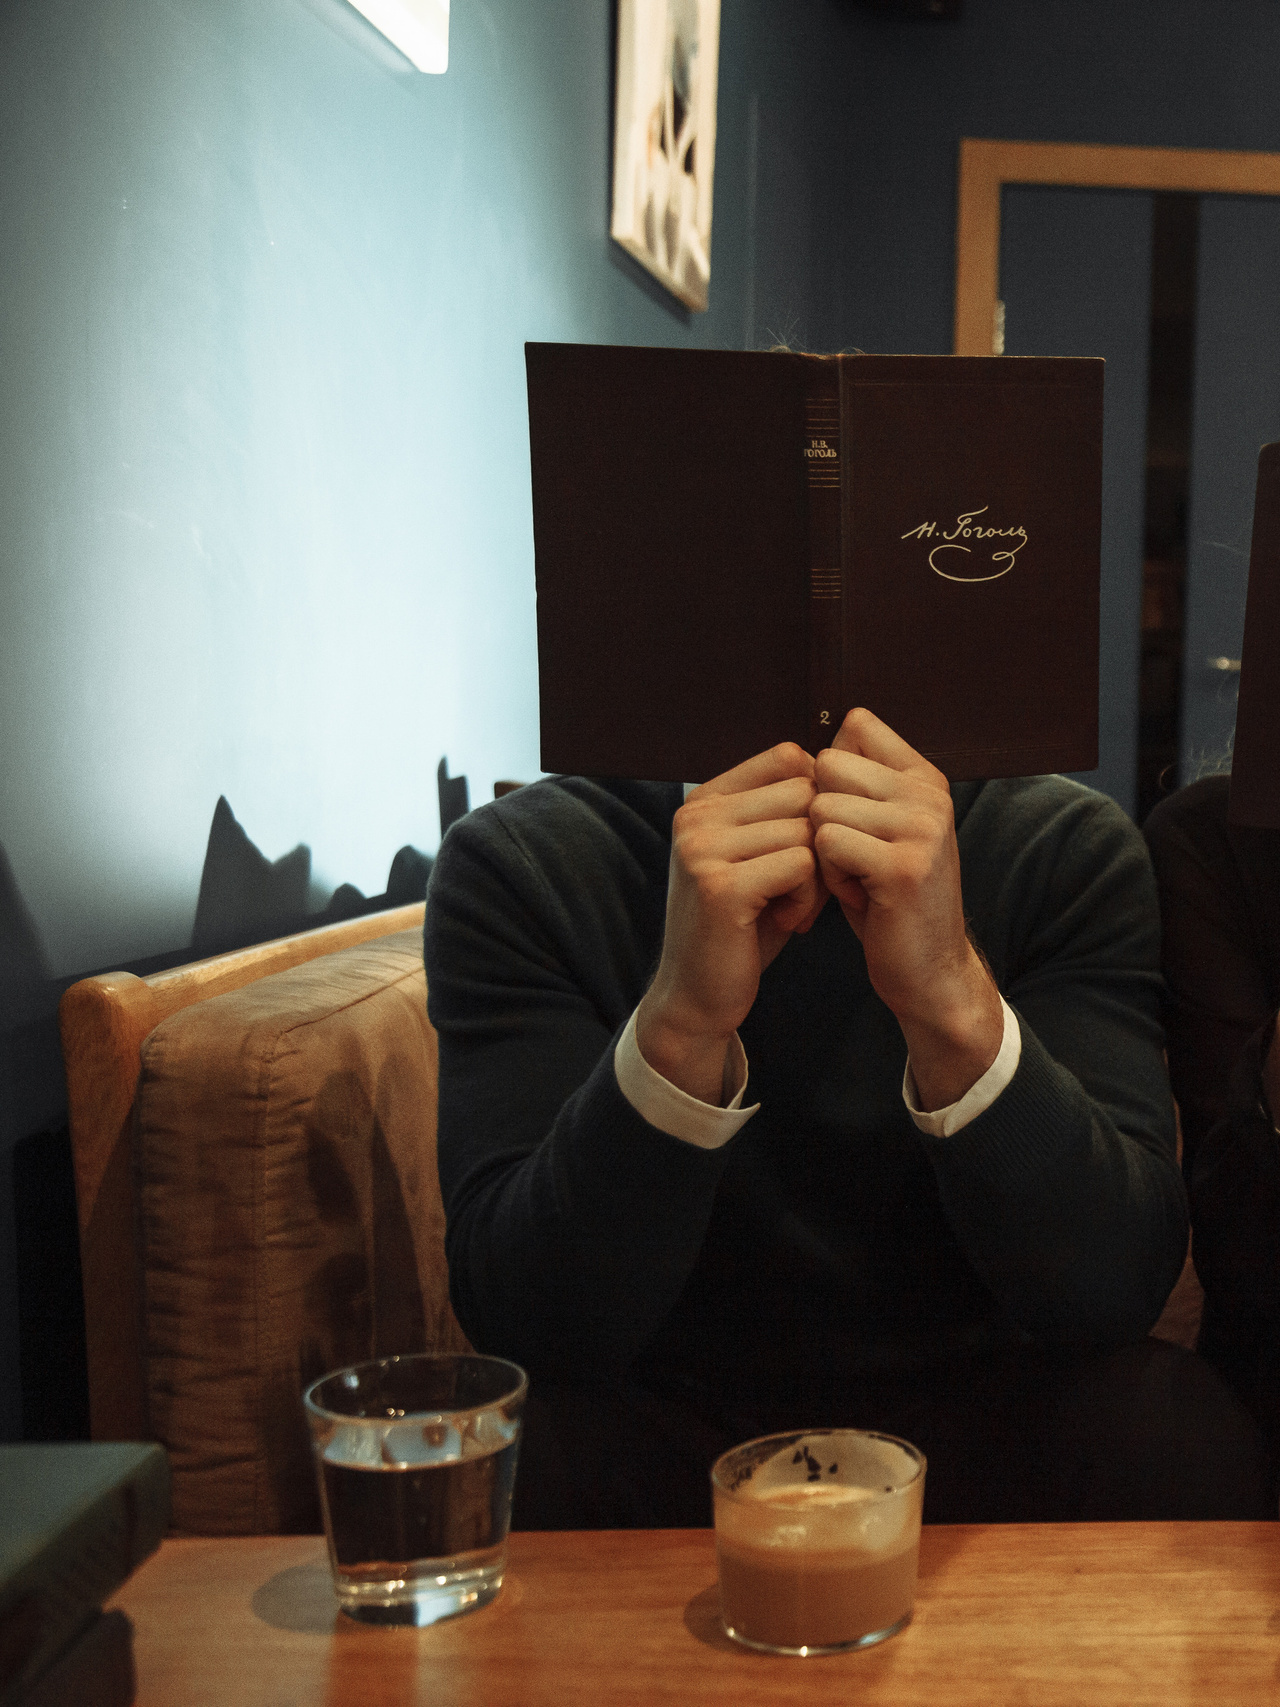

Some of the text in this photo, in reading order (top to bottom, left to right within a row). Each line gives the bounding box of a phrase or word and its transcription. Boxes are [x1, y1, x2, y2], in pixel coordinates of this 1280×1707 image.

[803, 449, 837, 458] ГОГОЛЬ
[901, 521, 940, 540] Н.
[820, 710, 830, 725] 2
